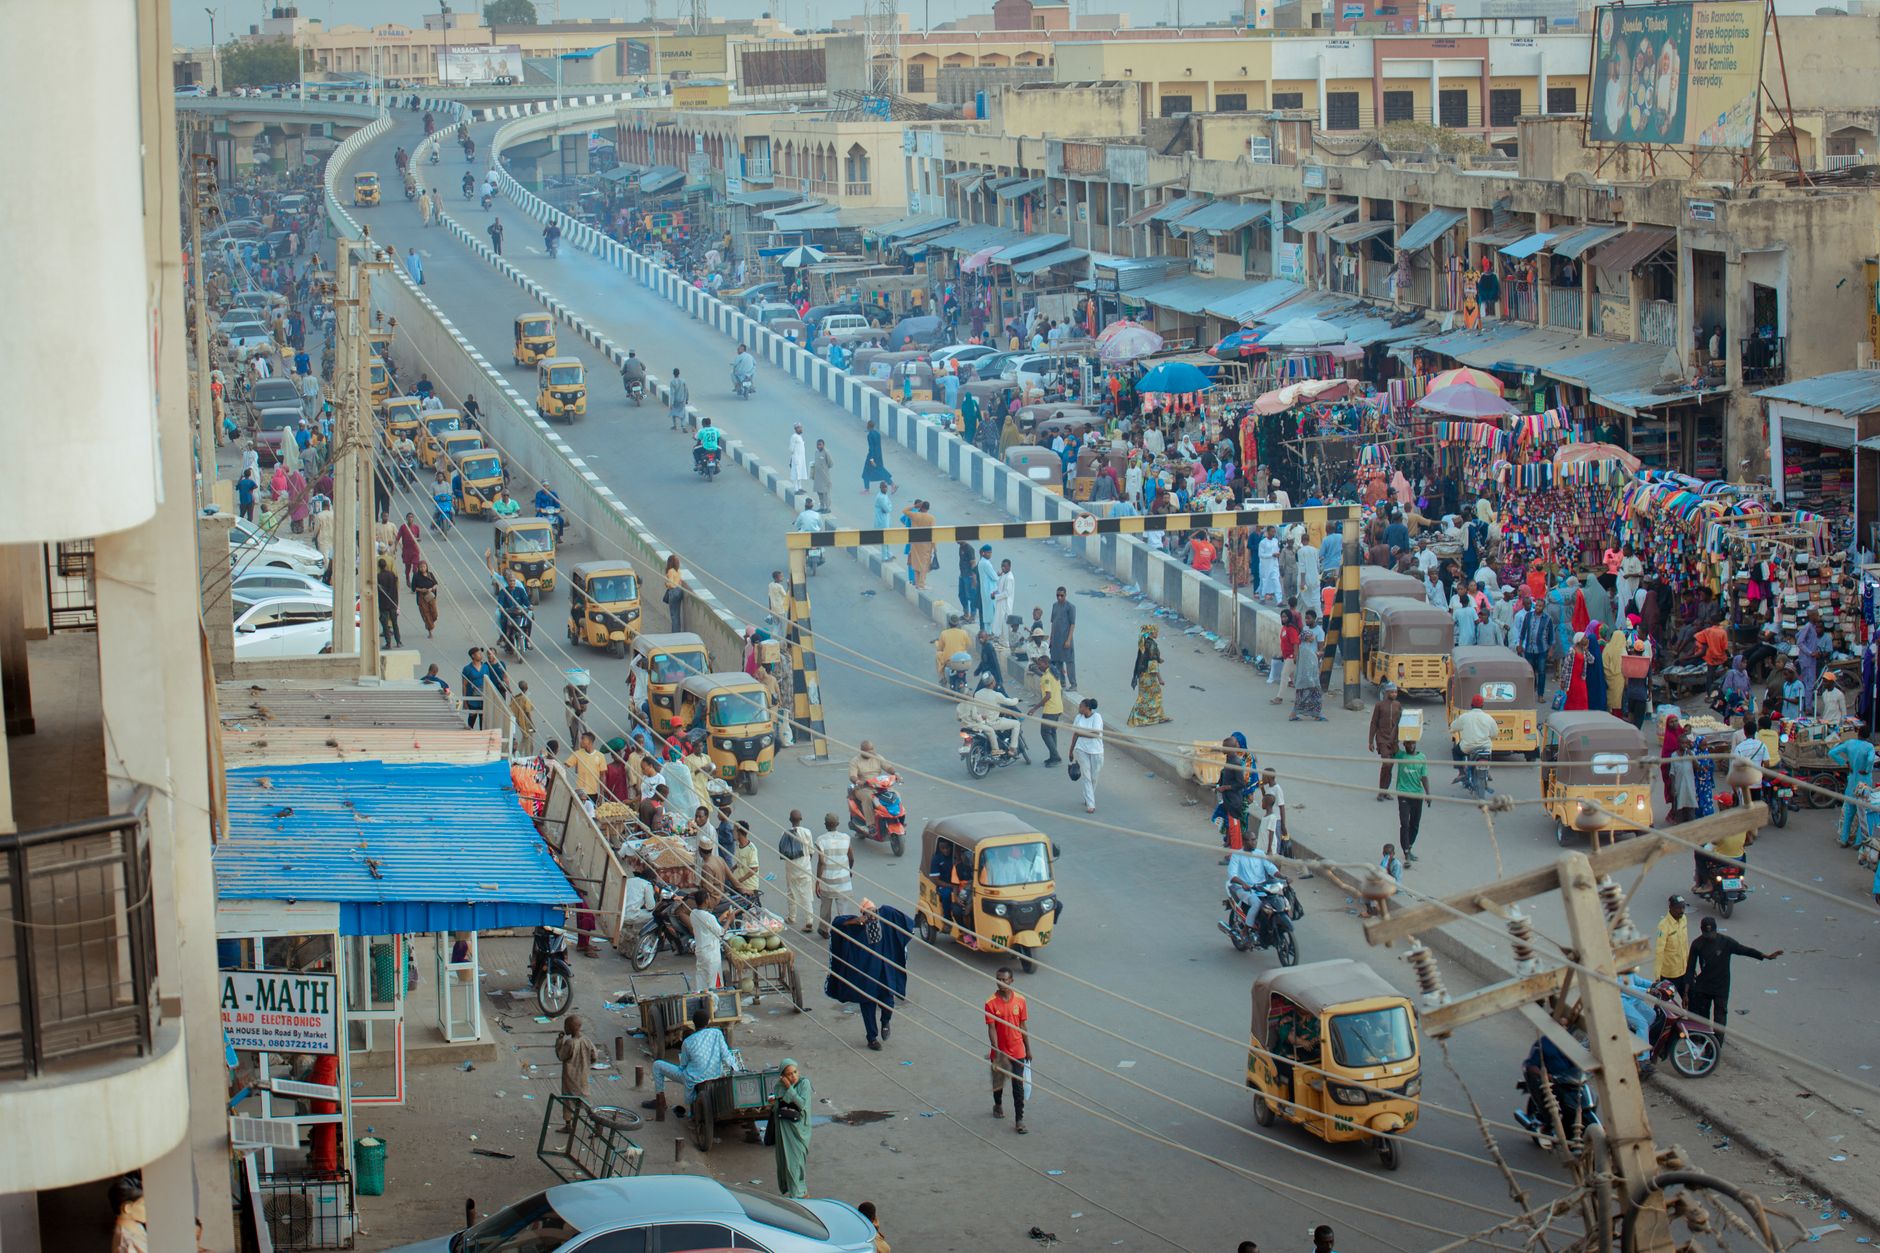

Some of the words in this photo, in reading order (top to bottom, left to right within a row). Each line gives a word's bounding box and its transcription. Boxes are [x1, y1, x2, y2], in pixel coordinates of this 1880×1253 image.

[1697, 11, 1709, 23] This
[1711, 11, 1745, 24] Ramadan,
[1695, 28, 1714, 39] Serve
[1715, 26, 1749, 42] Happiness
[1694, 44, 1707, 55] and
[1708, 42, 1734, 54] Nourish
[1693, 59, 1708, 70] Your
[1709, 59, 1737, 70] Families
[1692, 75, 1724, 88] everyday.
[236, 1013, 254, 1024] AND
[261, 1014, 321, 1027] ELECTRONICS
[235, 1027, 260, 1036] HOUSE
[293, 1029, 301, 1039] By
[303, 1031, 327, 1039] Market
[268, 1039, 328, 1049] 08037221214
